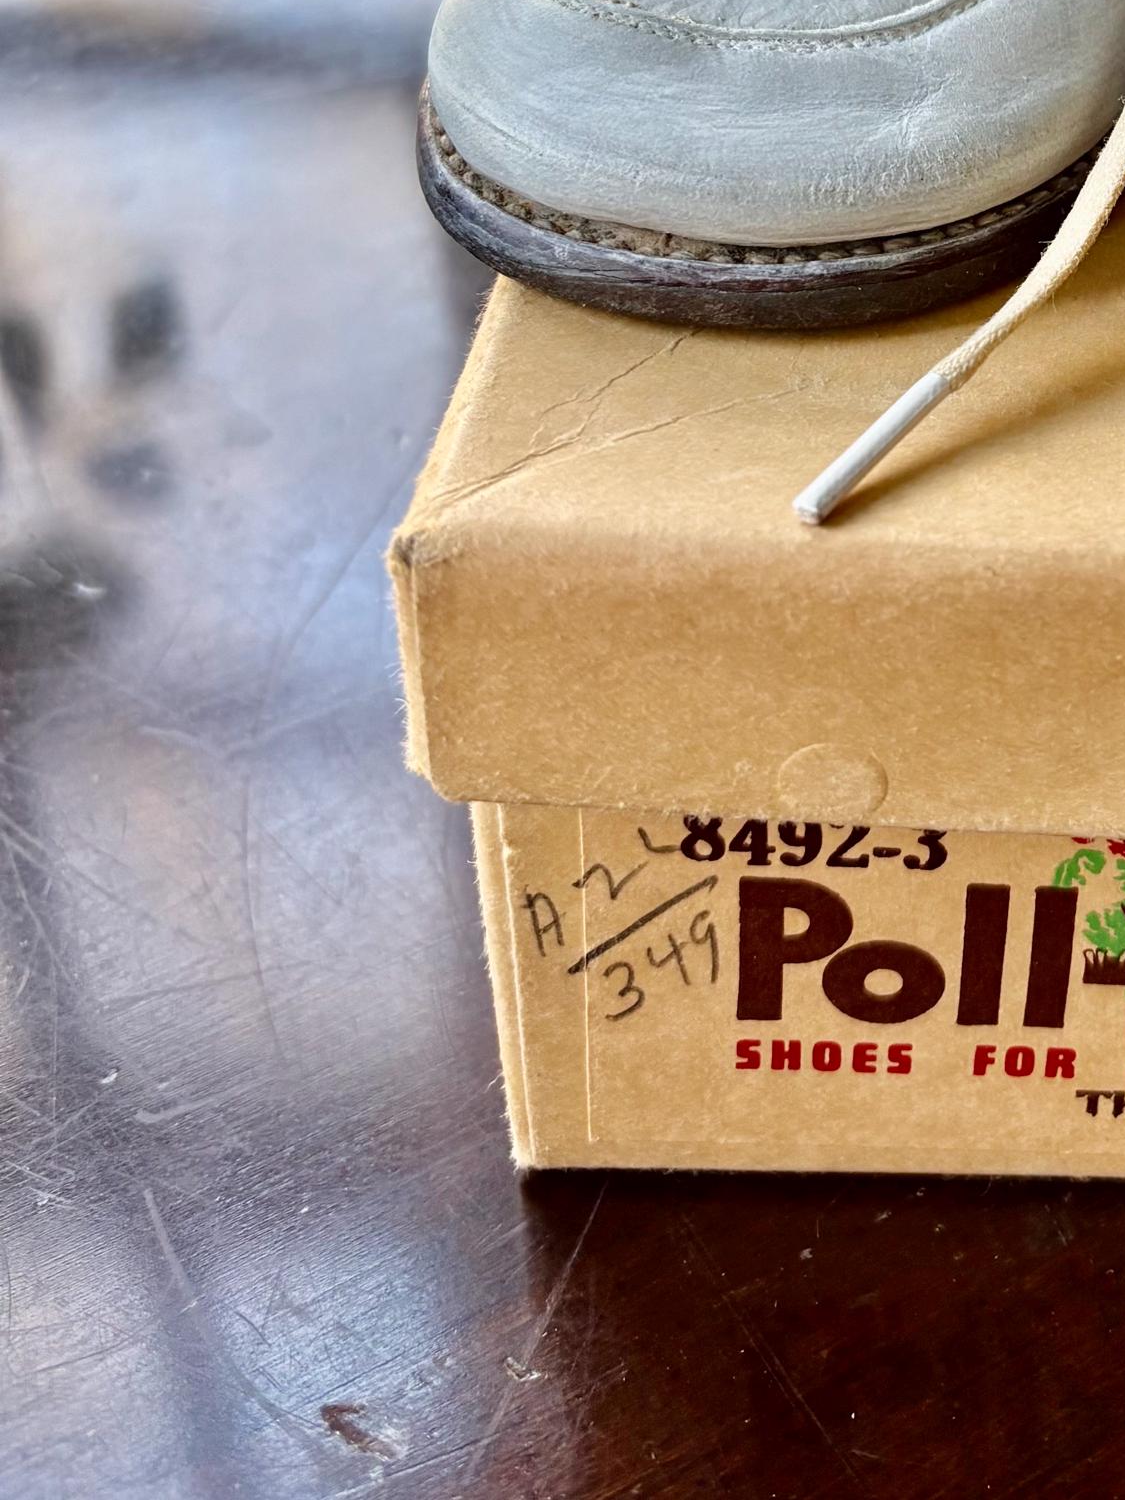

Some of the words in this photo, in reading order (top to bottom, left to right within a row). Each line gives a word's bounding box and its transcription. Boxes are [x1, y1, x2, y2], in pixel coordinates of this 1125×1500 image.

[680, 814, 948, 871] 8492-3
[735, 1039, 914, 1076] SHOES
[972, 1045, 1078, 1080] FOR
